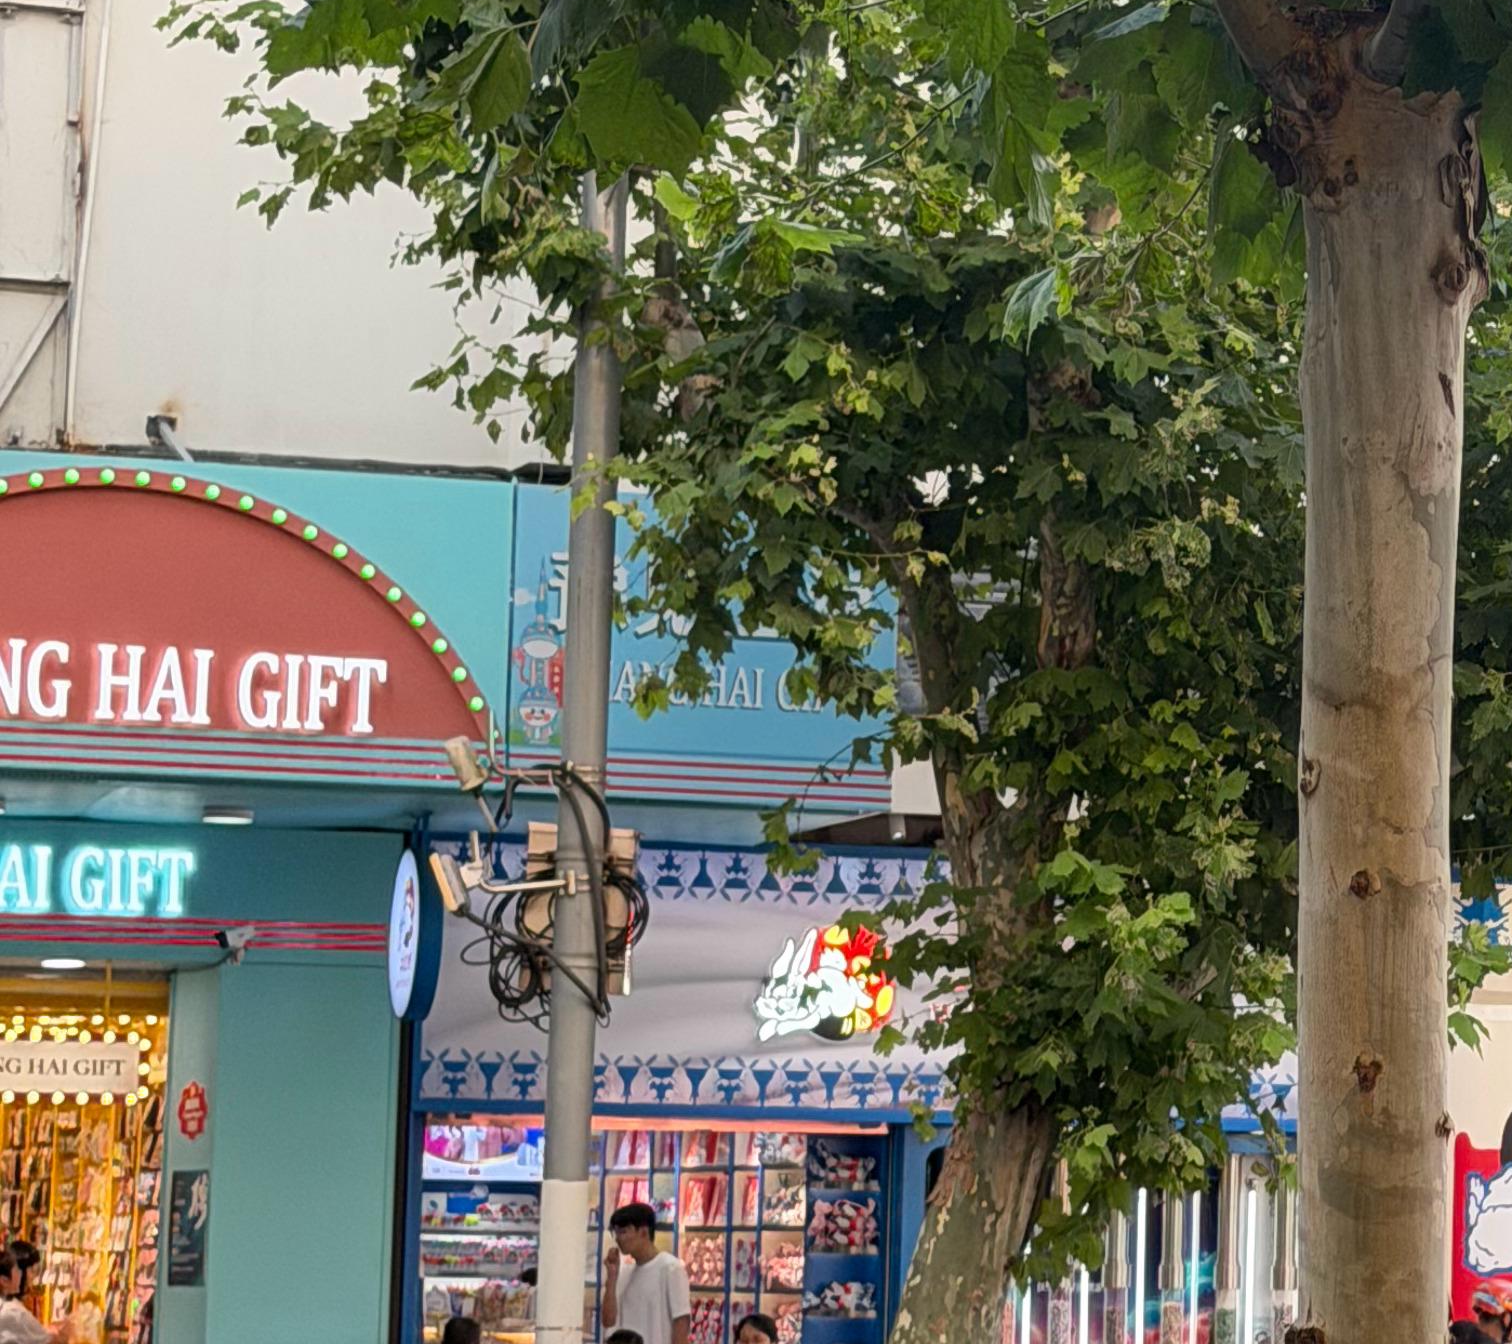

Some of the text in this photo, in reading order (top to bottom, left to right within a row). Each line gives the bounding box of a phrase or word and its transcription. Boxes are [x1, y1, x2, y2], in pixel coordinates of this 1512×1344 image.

[94, 642, 215, 725] HAI
[238, 651, 388, 733] GIFT
[68, 846, 195, 915] GIFT
[28, 1058, 68, 1075] HAI
[72, 1059, 126, 1076] GIFT
